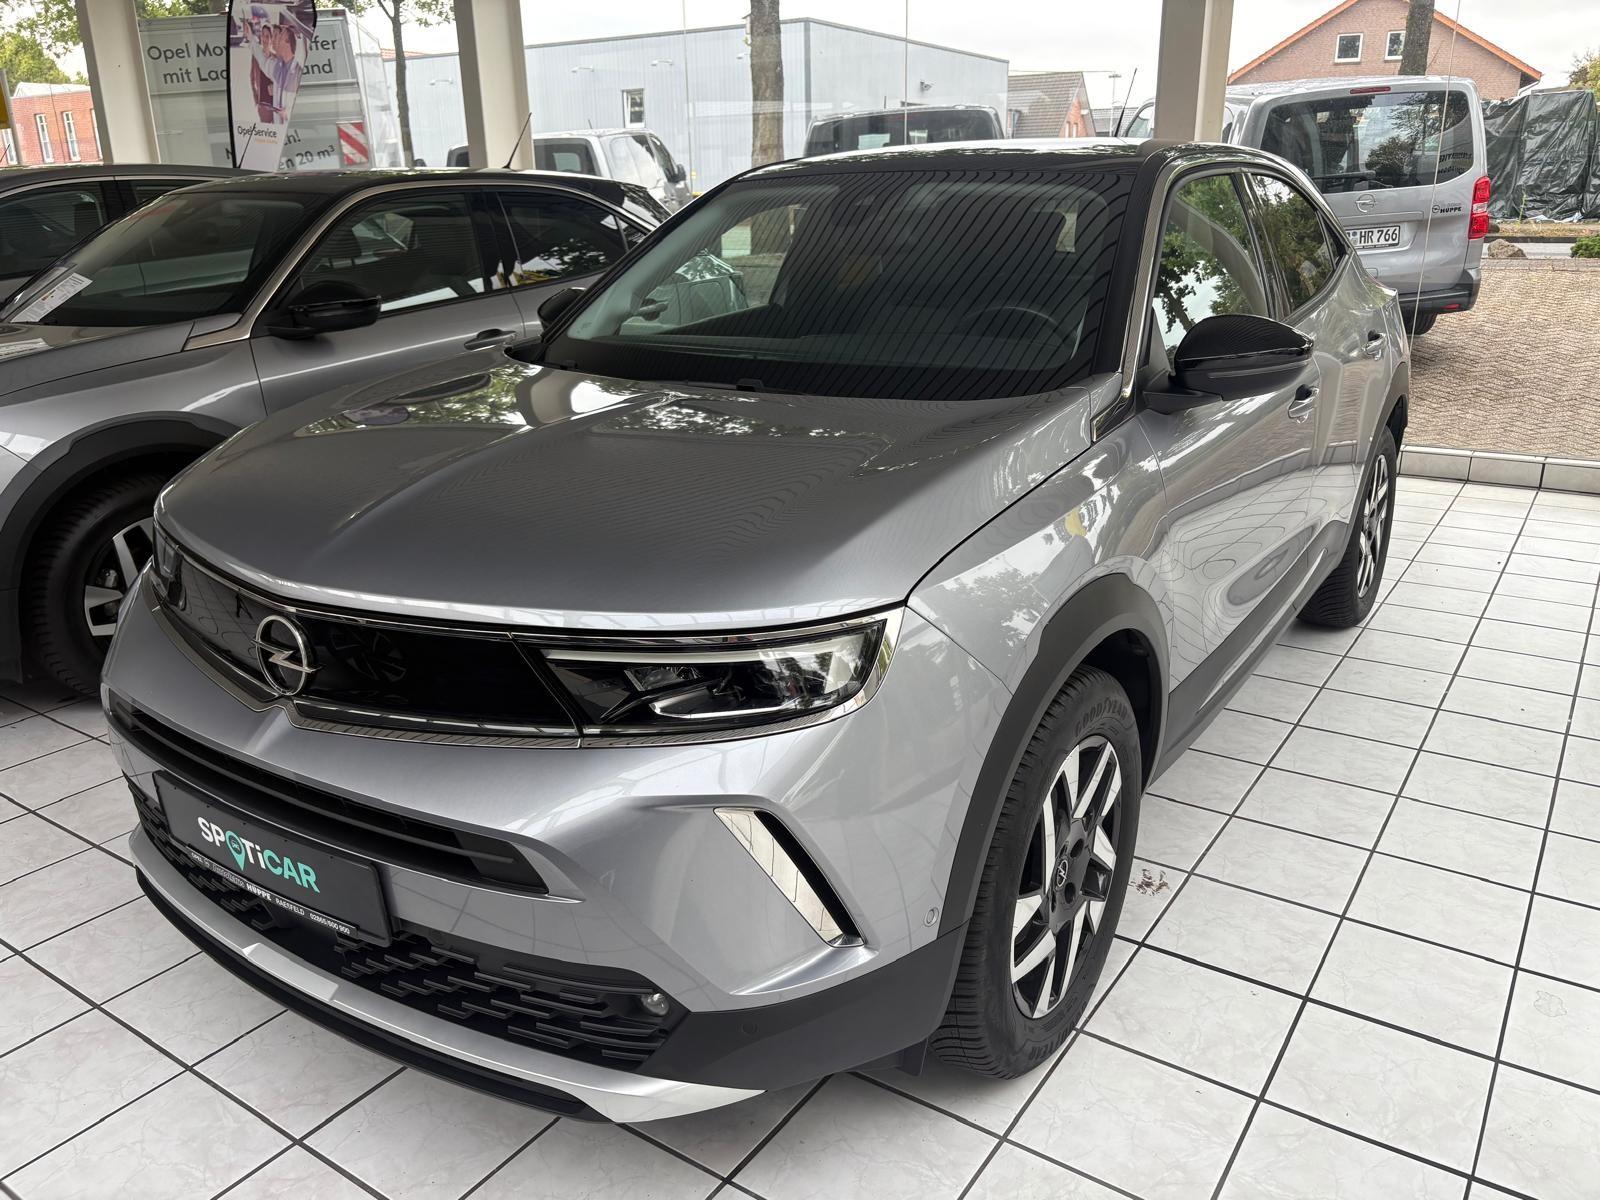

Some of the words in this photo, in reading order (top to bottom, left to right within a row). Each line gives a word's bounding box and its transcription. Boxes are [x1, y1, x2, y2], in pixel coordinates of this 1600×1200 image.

[147, 43, 191, 63] Opel
[309, 35, 337, 51] ffer
[163, 68, 192, 84] mit
[302, 58, 333, 75] and
[278, 157, 297, 171] en
[295, 150, 314, 166] 20
[1359, 230, 1374, 245] HR
[1377, 228, 1398, 243] 766
